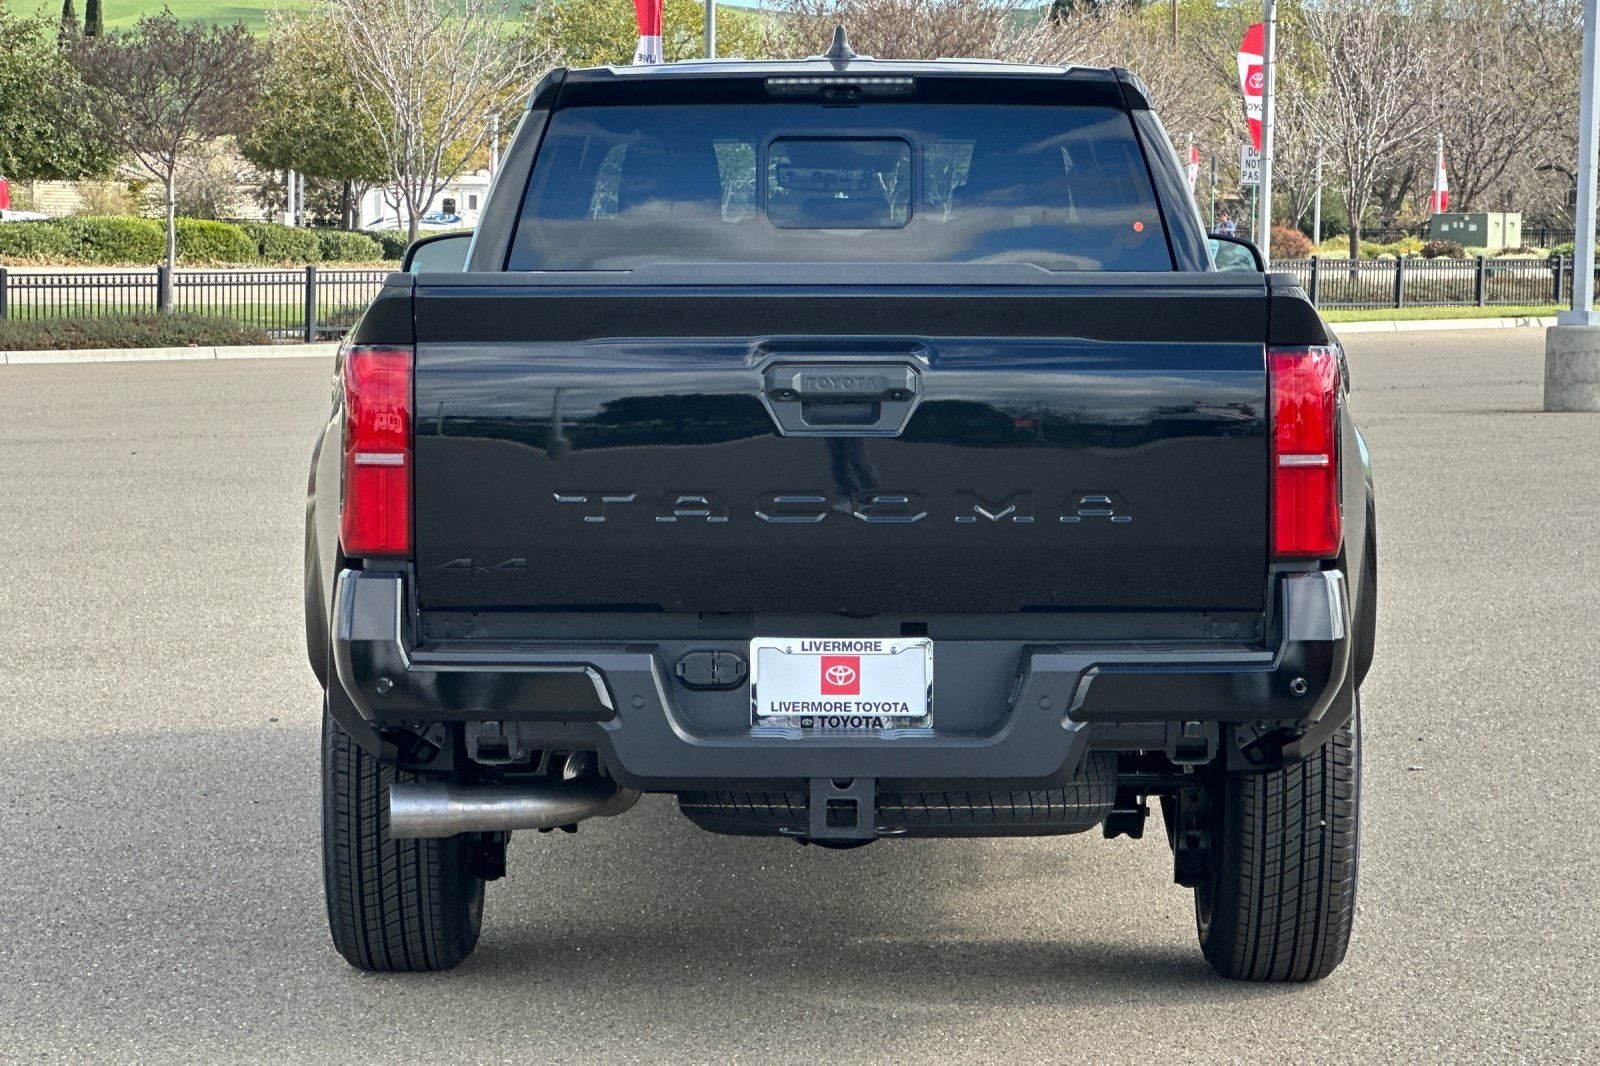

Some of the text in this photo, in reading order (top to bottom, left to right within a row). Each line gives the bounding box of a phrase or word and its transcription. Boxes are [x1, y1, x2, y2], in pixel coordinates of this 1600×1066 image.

[1245, 159, 1261, 169] NOT
[1242, 171, 1259, 180] PAS
[806, 377, 877, 391] TOYOTA
[551, 490, 1133, 523] TACOMA
[801, 641, 882, 652] LIVERMORE
[770, 701, 909, 713] LIVERMORE TOYOTA
[817, 716, 883, 728] TOYOTA
